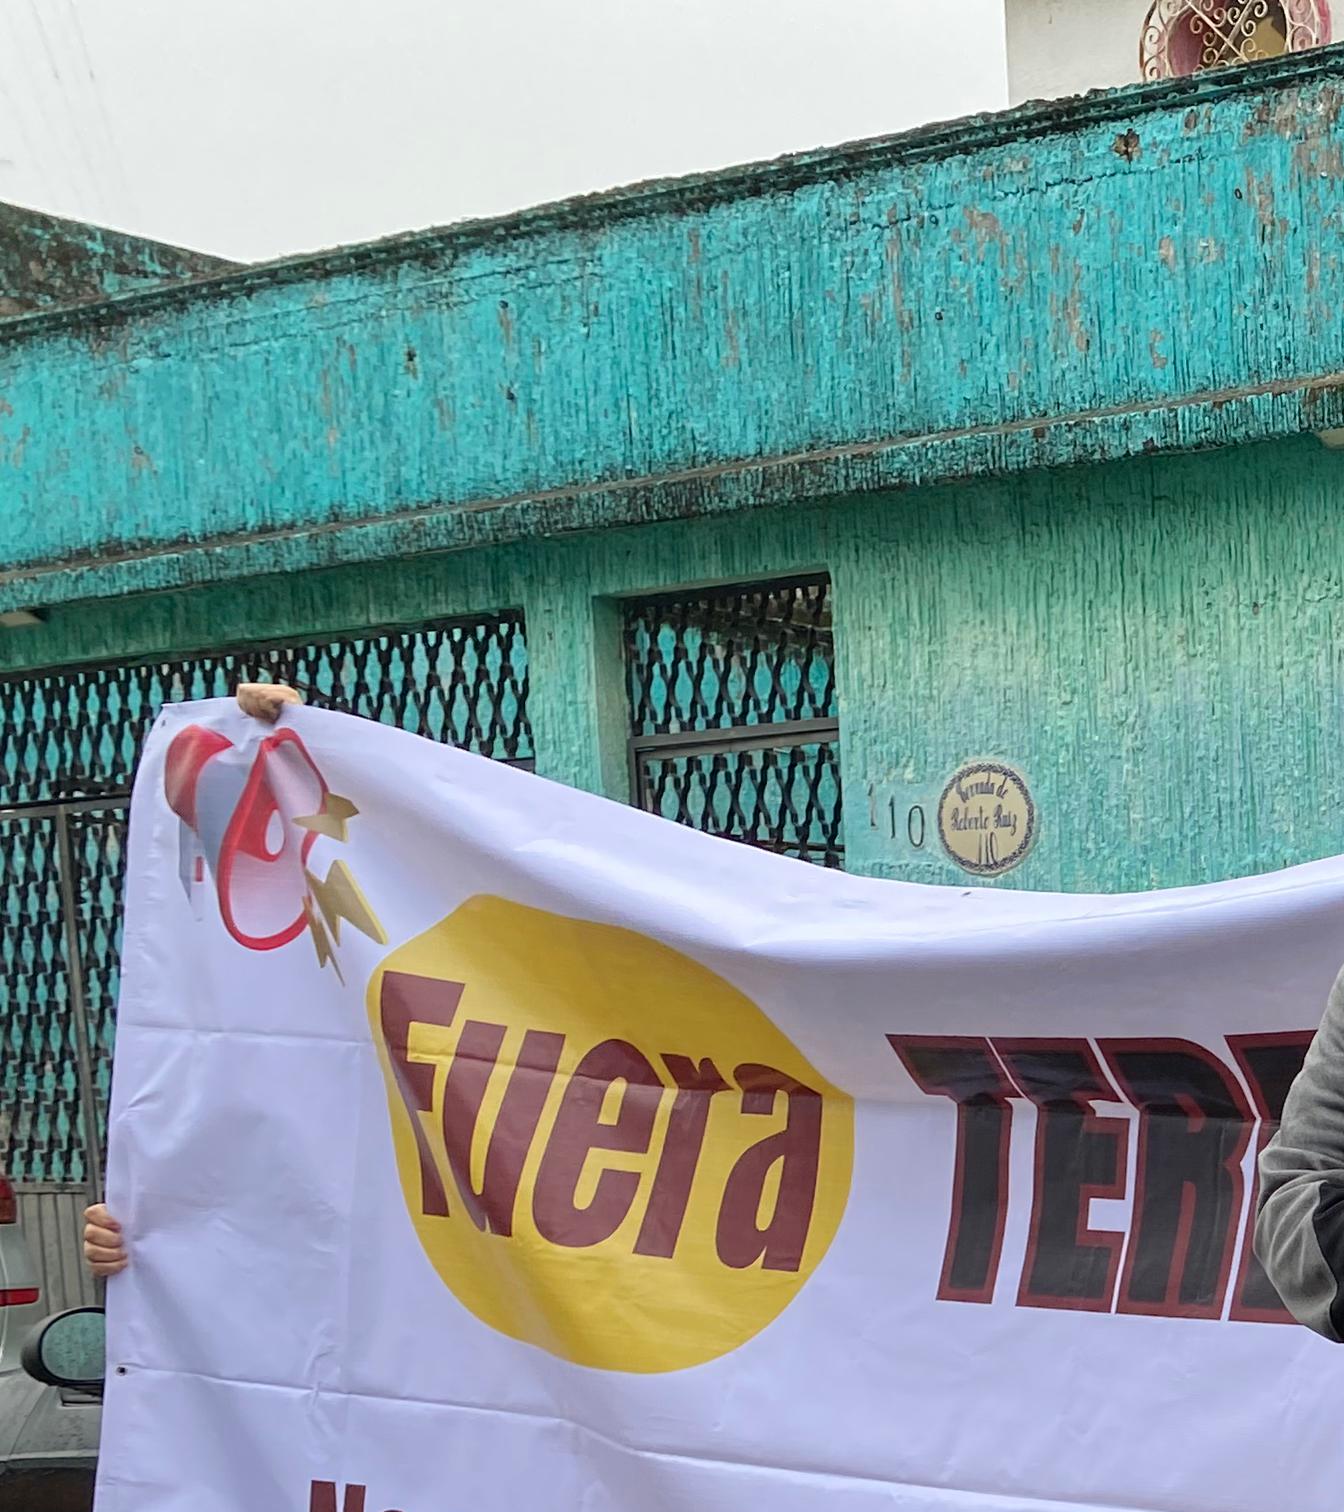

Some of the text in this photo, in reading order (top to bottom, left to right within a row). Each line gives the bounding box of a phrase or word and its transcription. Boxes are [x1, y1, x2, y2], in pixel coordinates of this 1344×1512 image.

[867, 782, 925, 848] 110
[996, 776, 1009, 799] de
[380, 970, 823, 1272] Fuera
